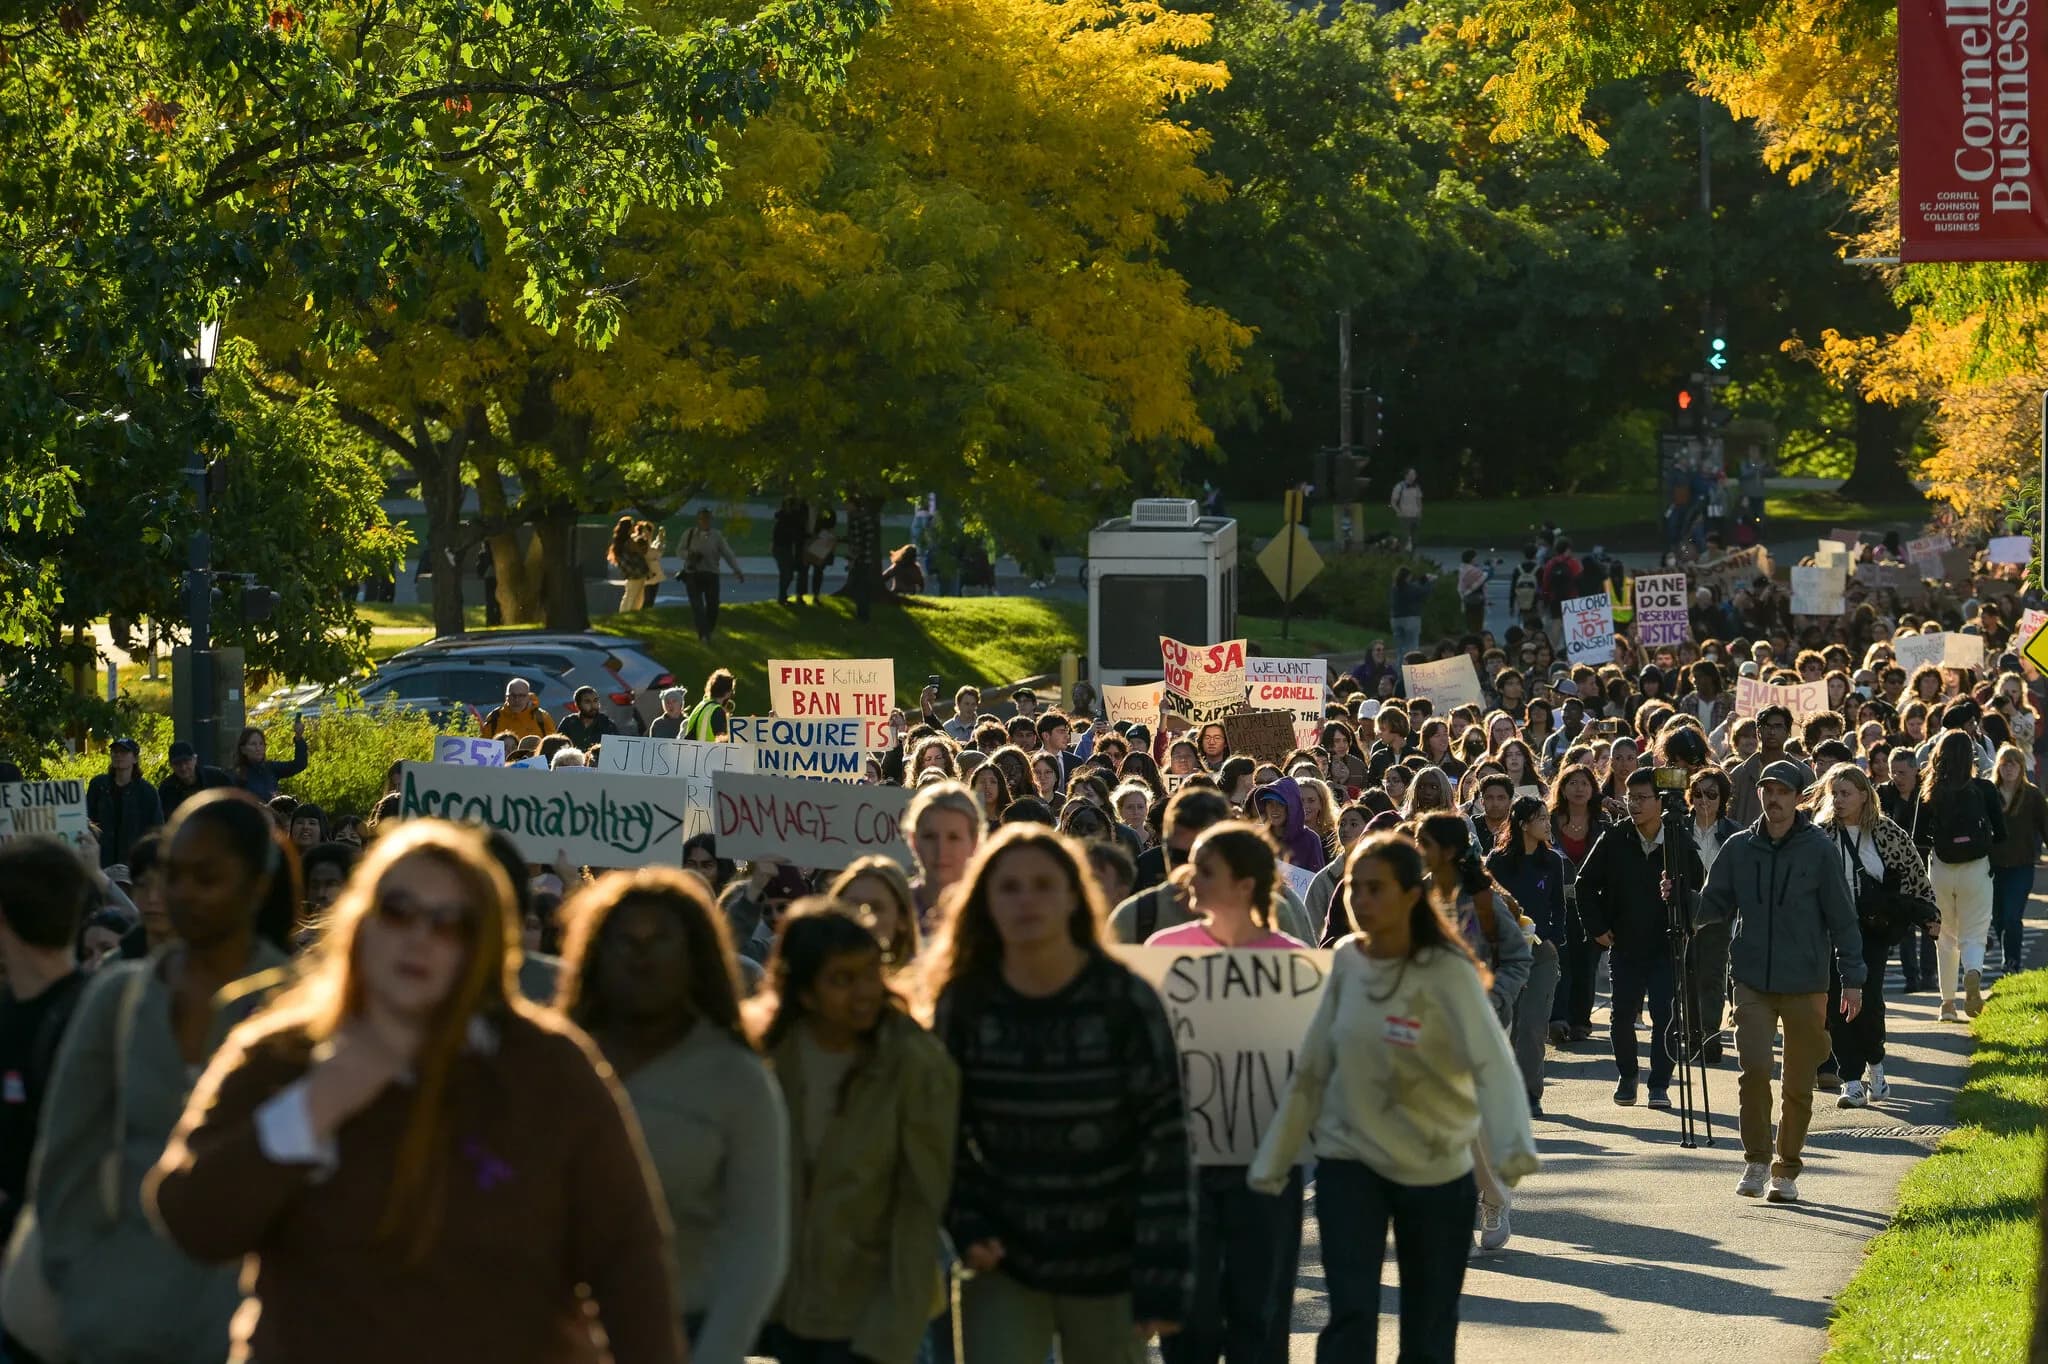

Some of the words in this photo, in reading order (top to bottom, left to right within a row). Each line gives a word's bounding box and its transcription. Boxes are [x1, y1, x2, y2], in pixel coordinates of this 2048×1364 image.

[1946, 0, 1995, 182] Cornell
[1993, 0, 2031, 213] Business
[1920, 202, 1932, 210] SC
[1934, 202, 1980, 210] JOHNSON
[1937, 191, 1980, 200] CORNELL
[1923, 213, 1965, 221] COLLEGE
[1966, 213, 1981, 221] OF
[1935, 223, 1980, 232] BUSINESS
[1637, 577, 1685, 593] JANE
[1640, 594, 1682, 608] DOE
[1576, 610, 1602, 625] IS
[1638, 609, 1688, 622] DESERVES
[1572, 620, 1609, 641] NOT
[1639, 622, 1688, 645] JUSTICE
[1567, 632, 1614, 655] CONSENT
[1162, 639, 1188, 667] CU
[1203, 643, 1244, 674] SA
[781, 667, 825, 685] FIRE
[1165, 662, 1194, 694] NOT
[1252, 662, 1274, 674] WE
[1277, 662, 1312, 675] WANT
[792, 690, 841, 716] BAN
[852, 693, 889, 717] THE
[1106, 695, 1149, 711] Whose
[1166, 689, 1194, 719] STOP
[1193, 700, 1247, 722] RAPIST
[1300, 711, 1320, 722] THE
[729, 718, 860, 747] REQUIRE
[613, 739, 740, 779] JUSTICE
[758, 748, 859, 774] INIMUM
[1, 784, 12, 808] E
[21, 781, 80, 807] STAND
[10, 807, 57, 833] WITH
[402, 771, 653, 853] Accountability
[718, 791, 848, 845] DAMAGE
[854, 803, 907, 845] CON
[1169, 954, 1322, 1002] STAND
[1181, 1049, 1296, 1154] RVIV
